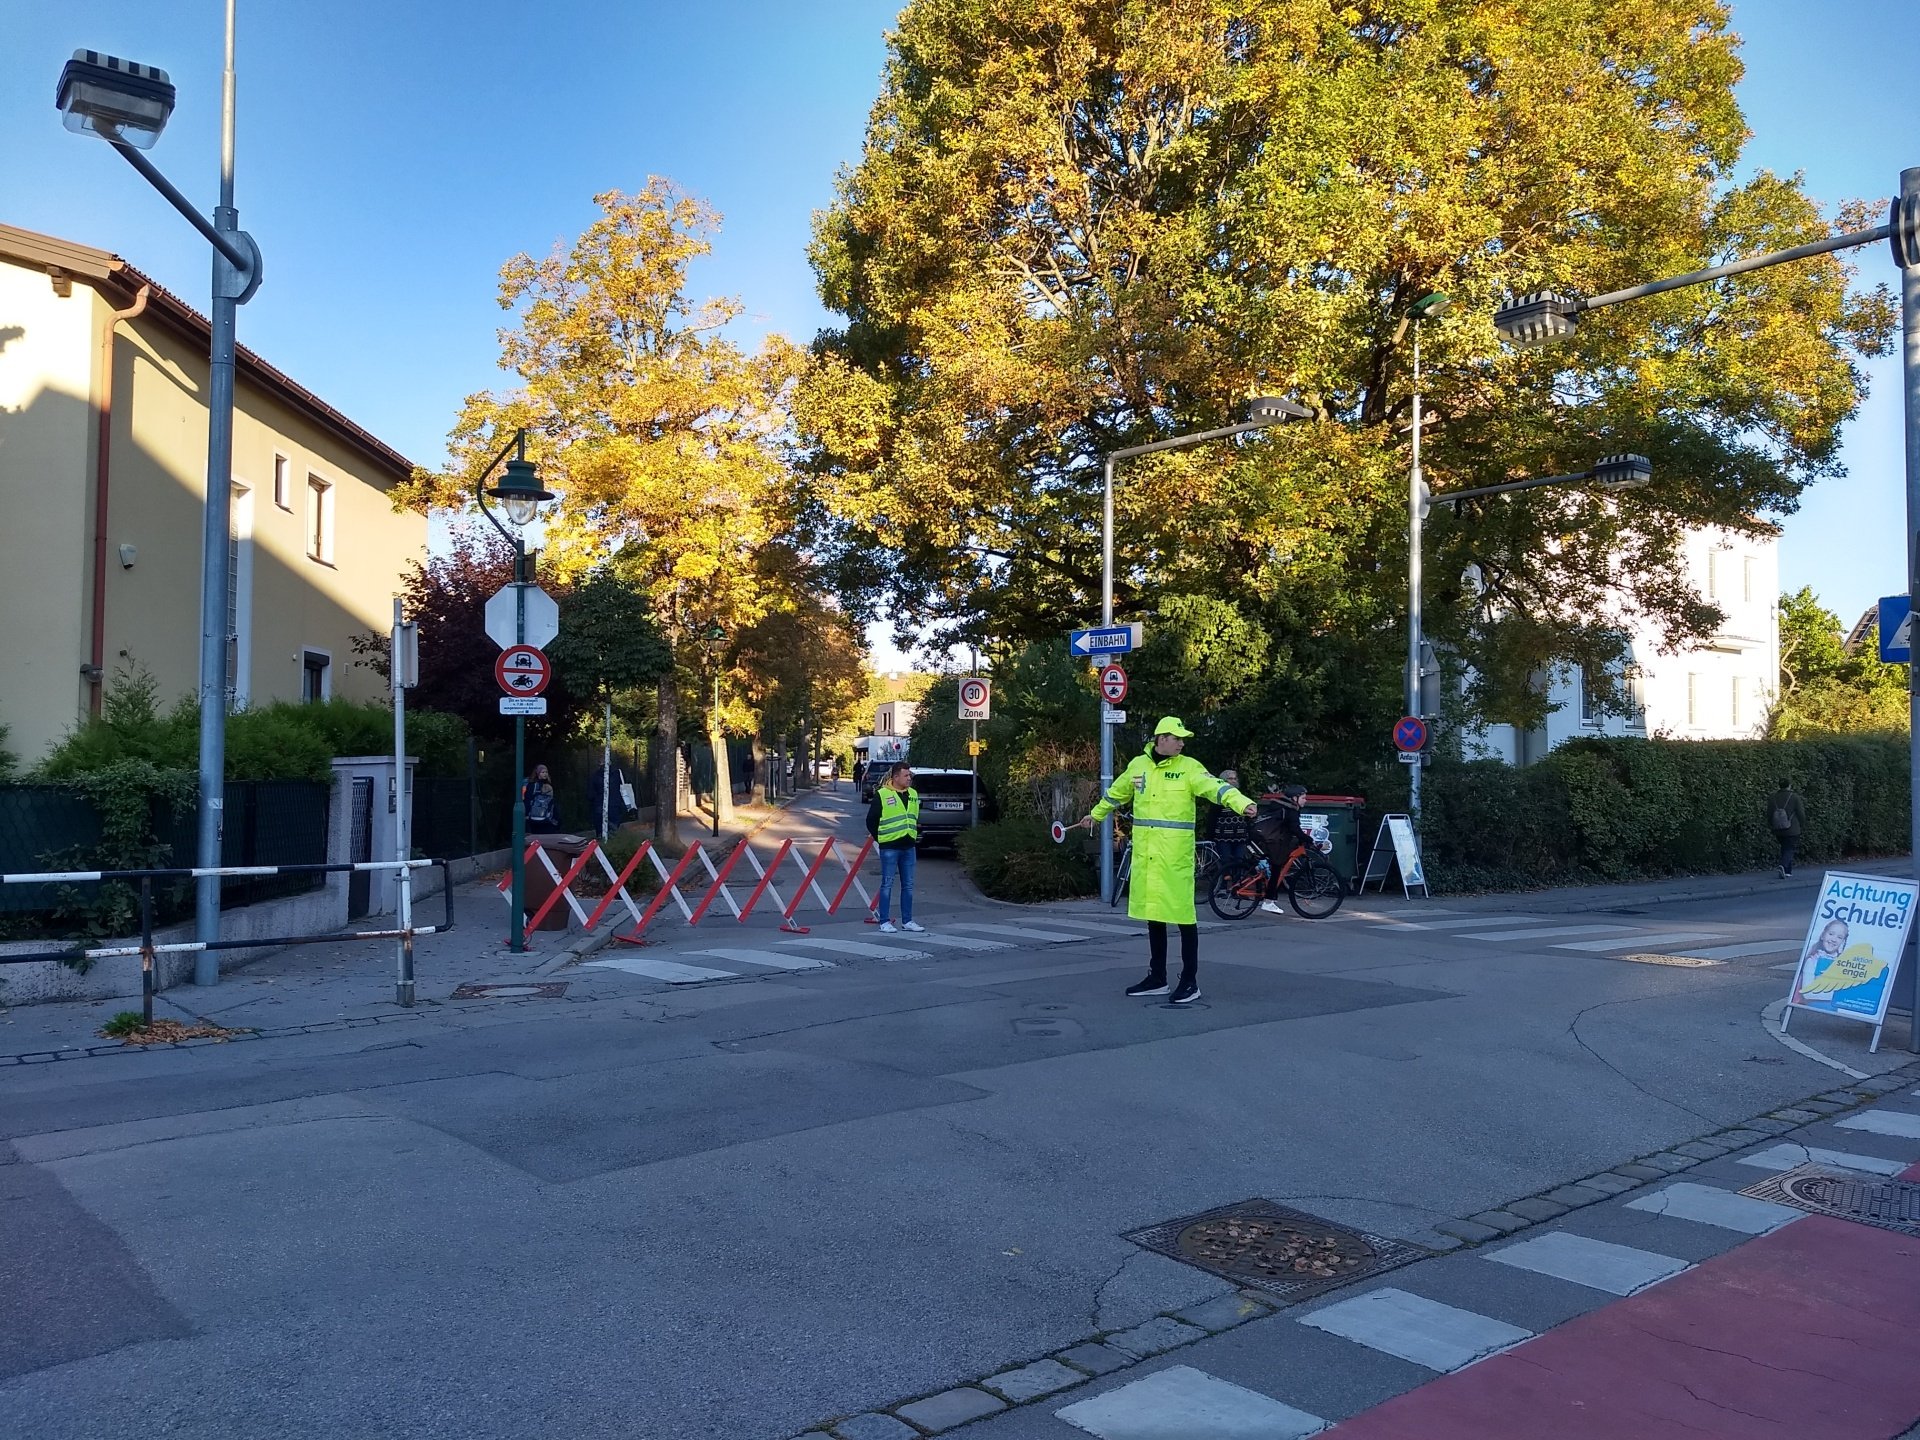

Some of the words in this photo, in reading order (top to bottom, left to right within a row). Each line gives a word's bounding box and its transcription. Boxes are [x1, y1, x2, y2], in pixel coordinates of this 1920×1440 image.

[1089, 634, 1126, 648] EINBAHN
[968, 687, 980, 700] 30
[964, 708, 984, 718] Zone
[1164, 771, 1181, 779] KfV
[1827, 879, 1912, 911] Achtung
[1820, 899, 1907, 930] Schule!
[1836, 959, 1867, 971] schutz
[1852, 956, 1873, 965] aktion
[1842, 968, 1868, 979] engel
